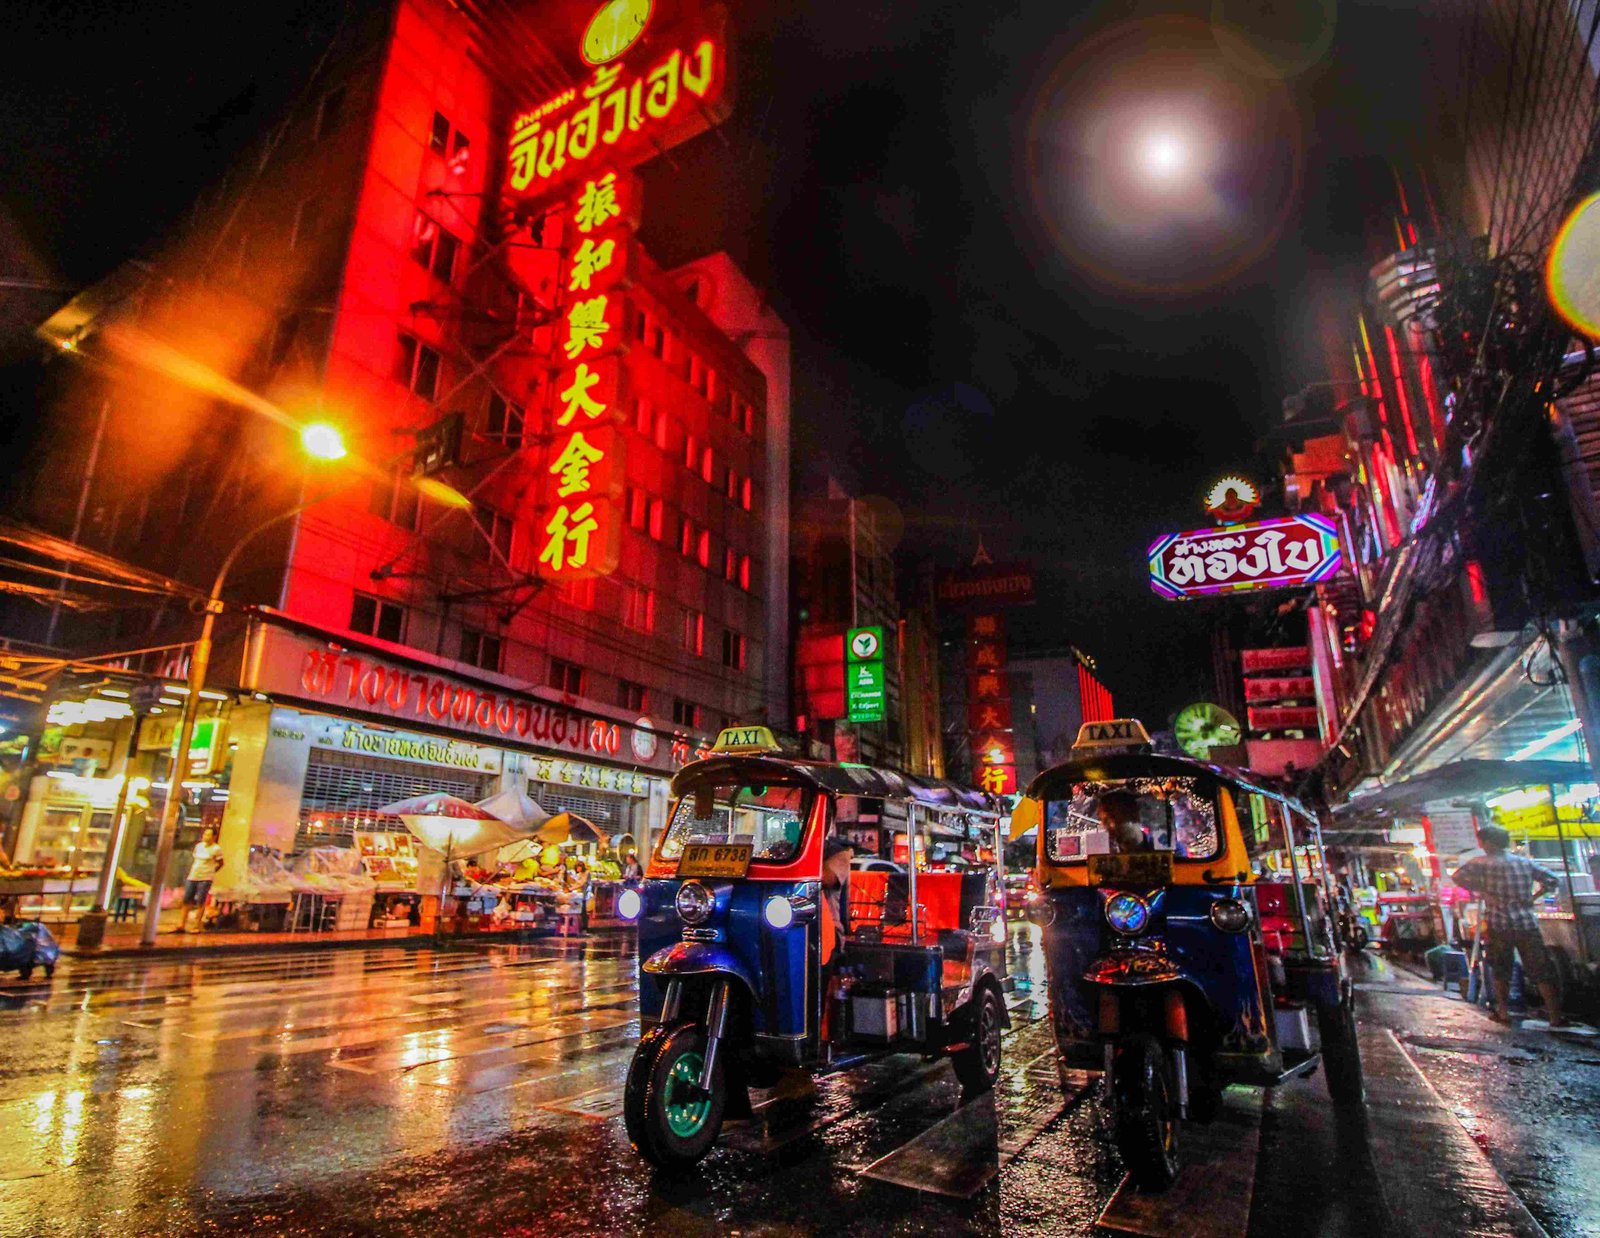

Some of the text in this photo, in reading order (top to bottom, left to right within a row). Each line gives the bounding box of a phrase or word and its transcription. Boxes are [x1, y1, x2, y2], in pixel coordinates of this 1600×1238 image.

[1168, 530, 1318, 585] ทองใบ
[724, 730, 759, 745] TAXI
[1088, 725, 1133, 739] TAXI
[714, 847, 747, 862] 6738
